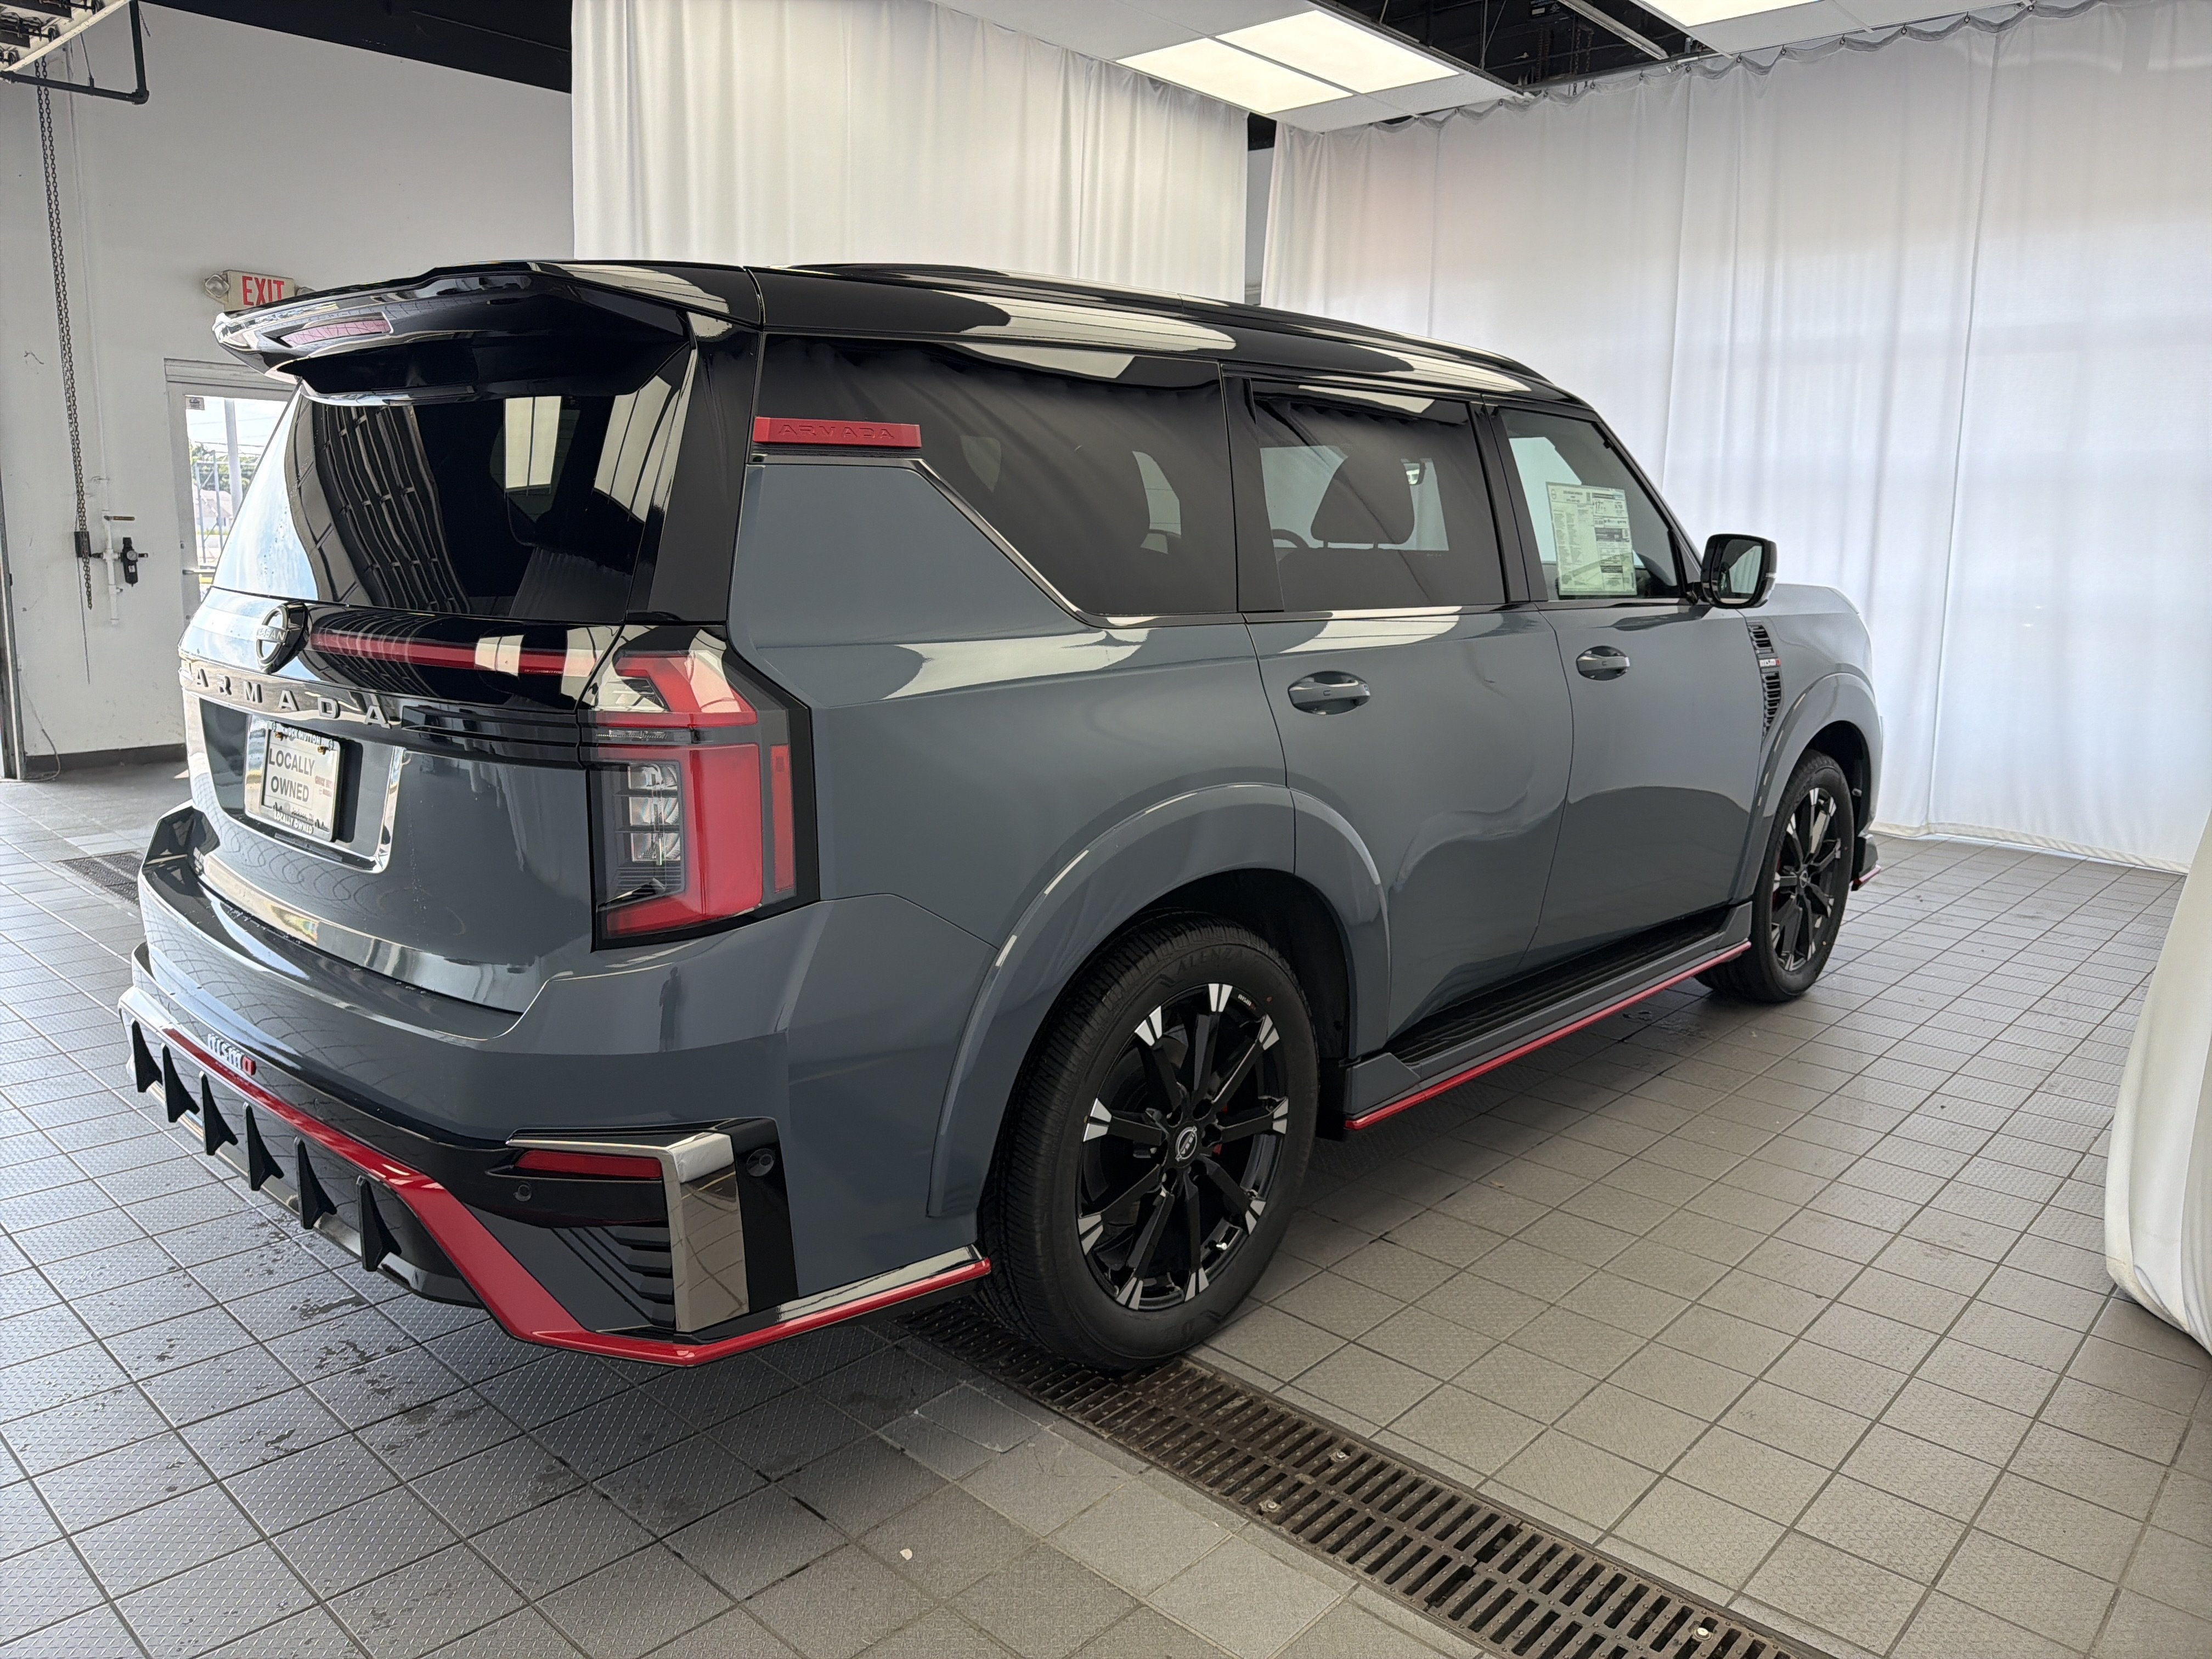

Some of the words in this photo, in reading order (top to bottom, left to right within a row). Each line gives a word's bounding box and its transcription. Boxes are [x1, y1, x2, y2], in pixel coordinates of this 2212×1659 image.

[242, 276, 284, 306] EXIT
[194, 668, 392, 730] ARMADA
[269, 748, 314, 776] LOCALLY
[271, 776, 309, 802] OWNED
[1177, 948, 1244, 972] ALENZA
